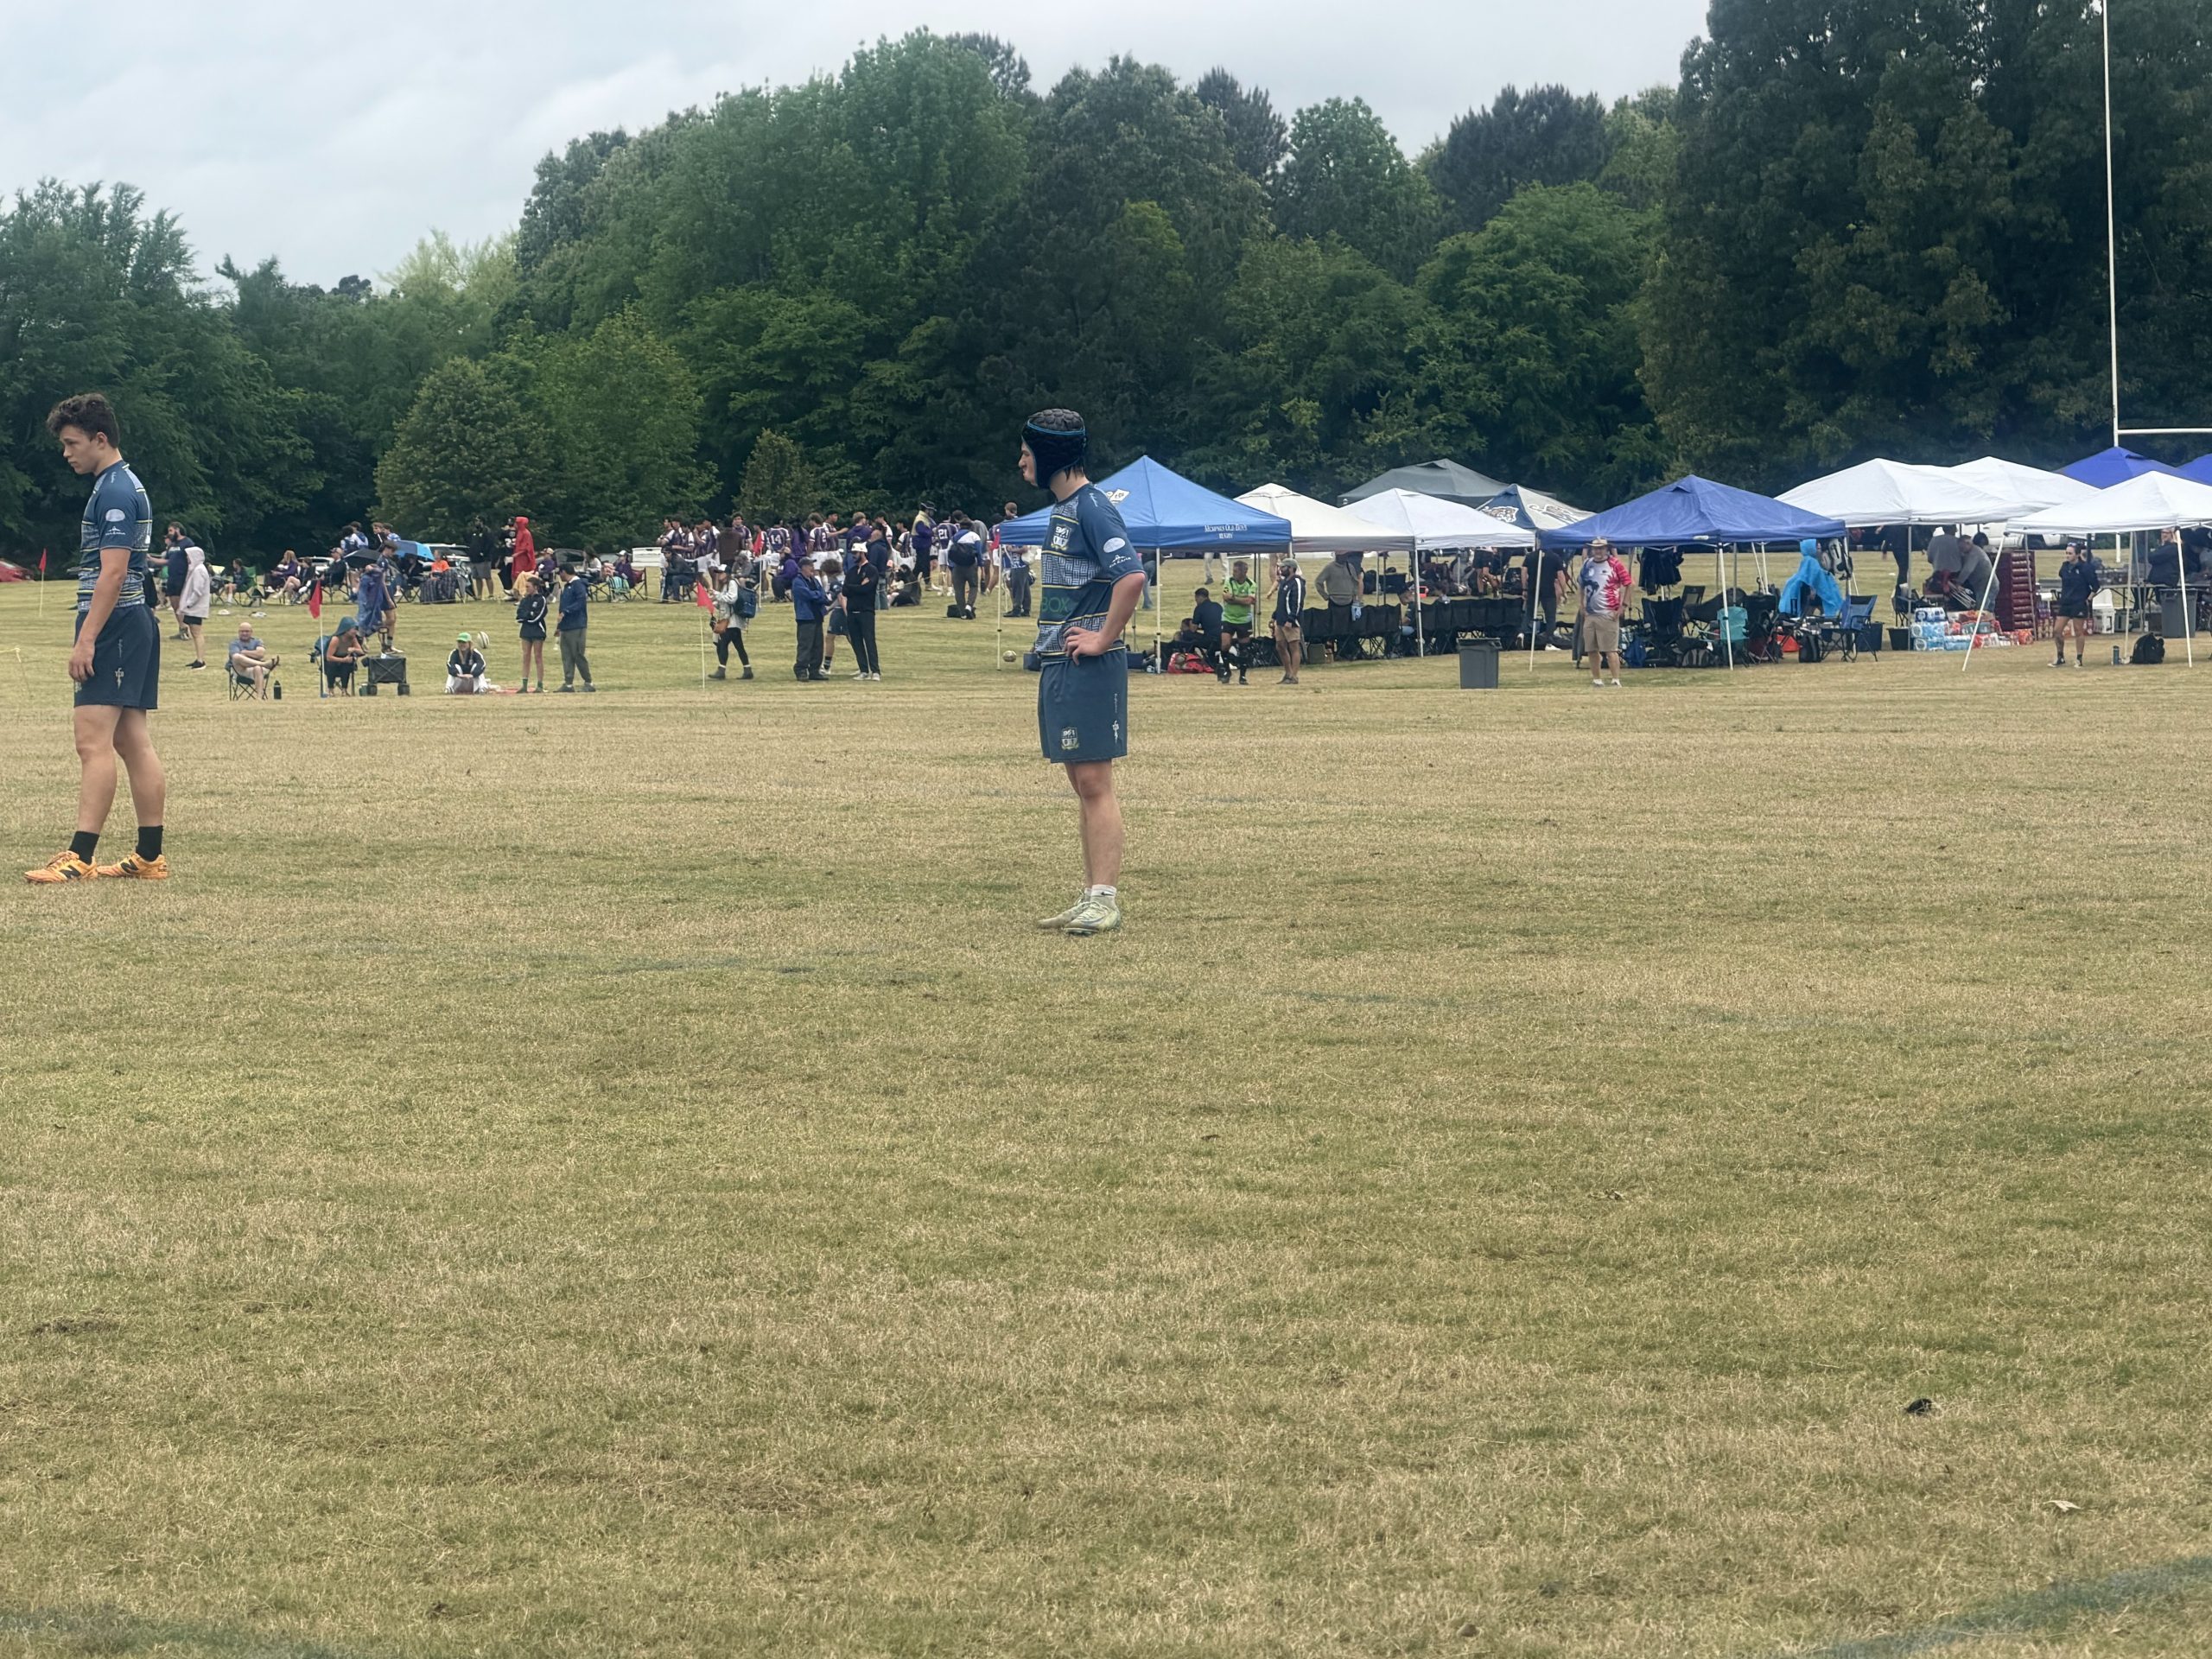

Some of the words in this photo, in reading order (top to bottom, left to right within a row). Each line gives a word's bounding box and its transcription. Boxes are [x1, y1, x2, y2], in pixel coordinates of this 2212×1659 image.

[771, 534, 782, 544] 14
[822, 532, 826, 543] 2
[938, 528, 948, 539] 21
